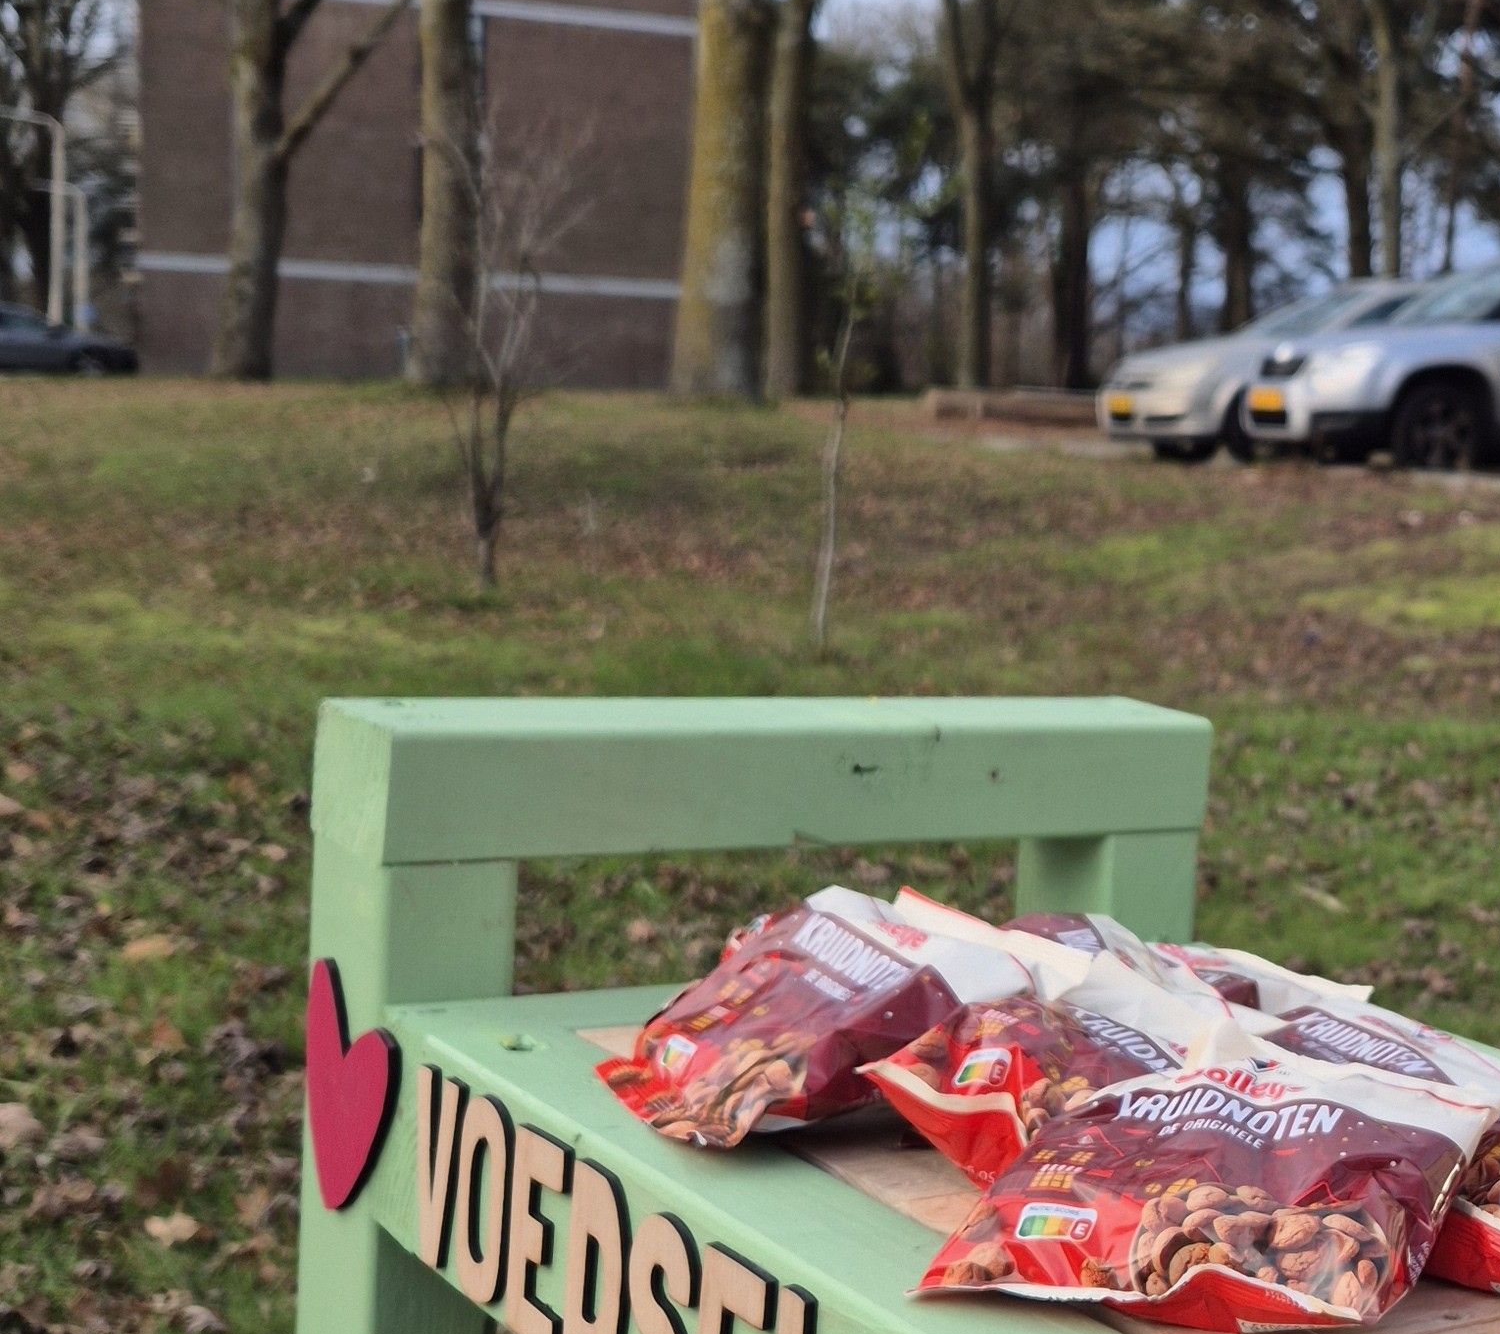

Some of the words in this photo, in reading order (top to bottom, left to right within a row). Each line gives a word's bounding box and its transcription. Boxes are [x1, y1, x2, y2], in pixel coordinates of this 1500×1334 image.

[1157, 1121, 1178, 1137] DE
[1182, 1119, 1265, 1149] ORIGINELE
[1073, 1222, 1089, 1236] E
